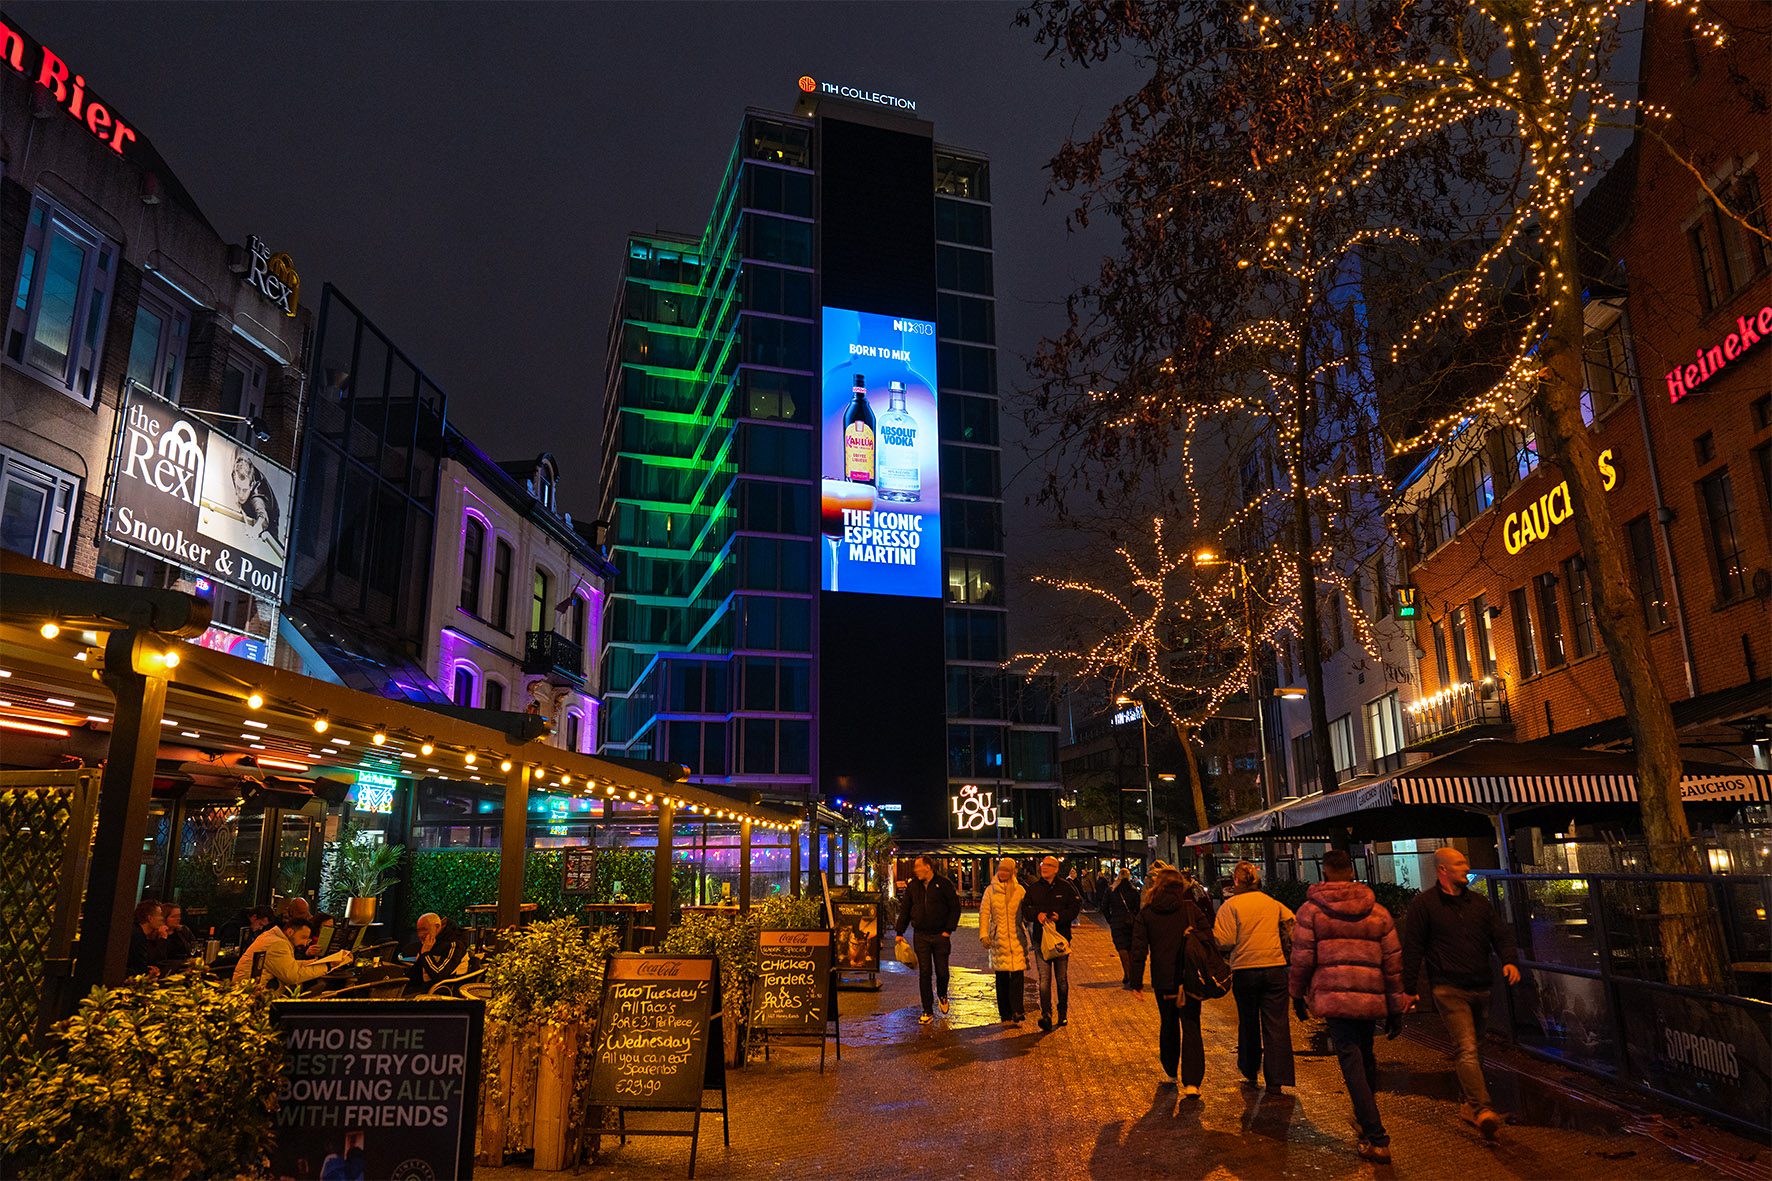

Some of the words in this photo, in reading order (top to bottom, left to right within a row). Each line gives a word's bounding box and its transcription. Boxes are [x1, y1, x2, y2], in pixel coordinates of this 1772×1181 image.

[35, 45, 136, 154] Bier
[841, 87, 916, 110] COLLECTION
[252, 235, 271, 260] the
[247, 249, 293, 313] Rex
[849, 343, 876, 357] BORN
[878, 348, 890, 358] TO
[892, 350, 911, 362] MIX
[130, 404, 160, 436] the
[881, 426, 916, 438] ABSOLUT
[884, 436, 914, 447] VODKA
[121, 428, 194, 505] Rex
[1503, 448, 1616, 555] GAUCS
[842, 508, 871, 527] THE
[874, 511, 922, 532] ICONIC
[845, 526, 920, 548] ESPRESSO
[116, 507, 211, 565] Snooker
[215, 549, 233, 576] &
[239, 557, 278, 593] Pool
[850, 544, 916, 565] MARTINI
[1680, 779, 1745, 797] GAUCHOS
[952, 793, 992, 814] LOU
[957, 808, 997, 830] LOU
[610, 983, 642, 999] Taco
[642, 984, 697, 1002] Tuesday
[779, 986, 790, 999] &
[621, 1001, 639, 1014] All
[640, 1001, 676, 1014] Taco's
[287, 1028, 345, 1050] WHO
[350, 1028, 373, 1050] IS
[378, 1028, 425, 1050] THE
[607, 1034, 691, 1053] Wednesday
[283, 1054, 355, 1076] BEST?
[361, 1054, 408, 1076] TRY
[411, 1054, 464, 1076] OUR
[602, 1051, 617, 1064] All
[618, 1053, 640, 1070] you
[643, 1054, 666, 1063] can
[279, 1079, 392, 1101] BOWLING
[276, 1105, 339, 1127] WITH
[344, 1105, 448, 1127] FRIENDS
